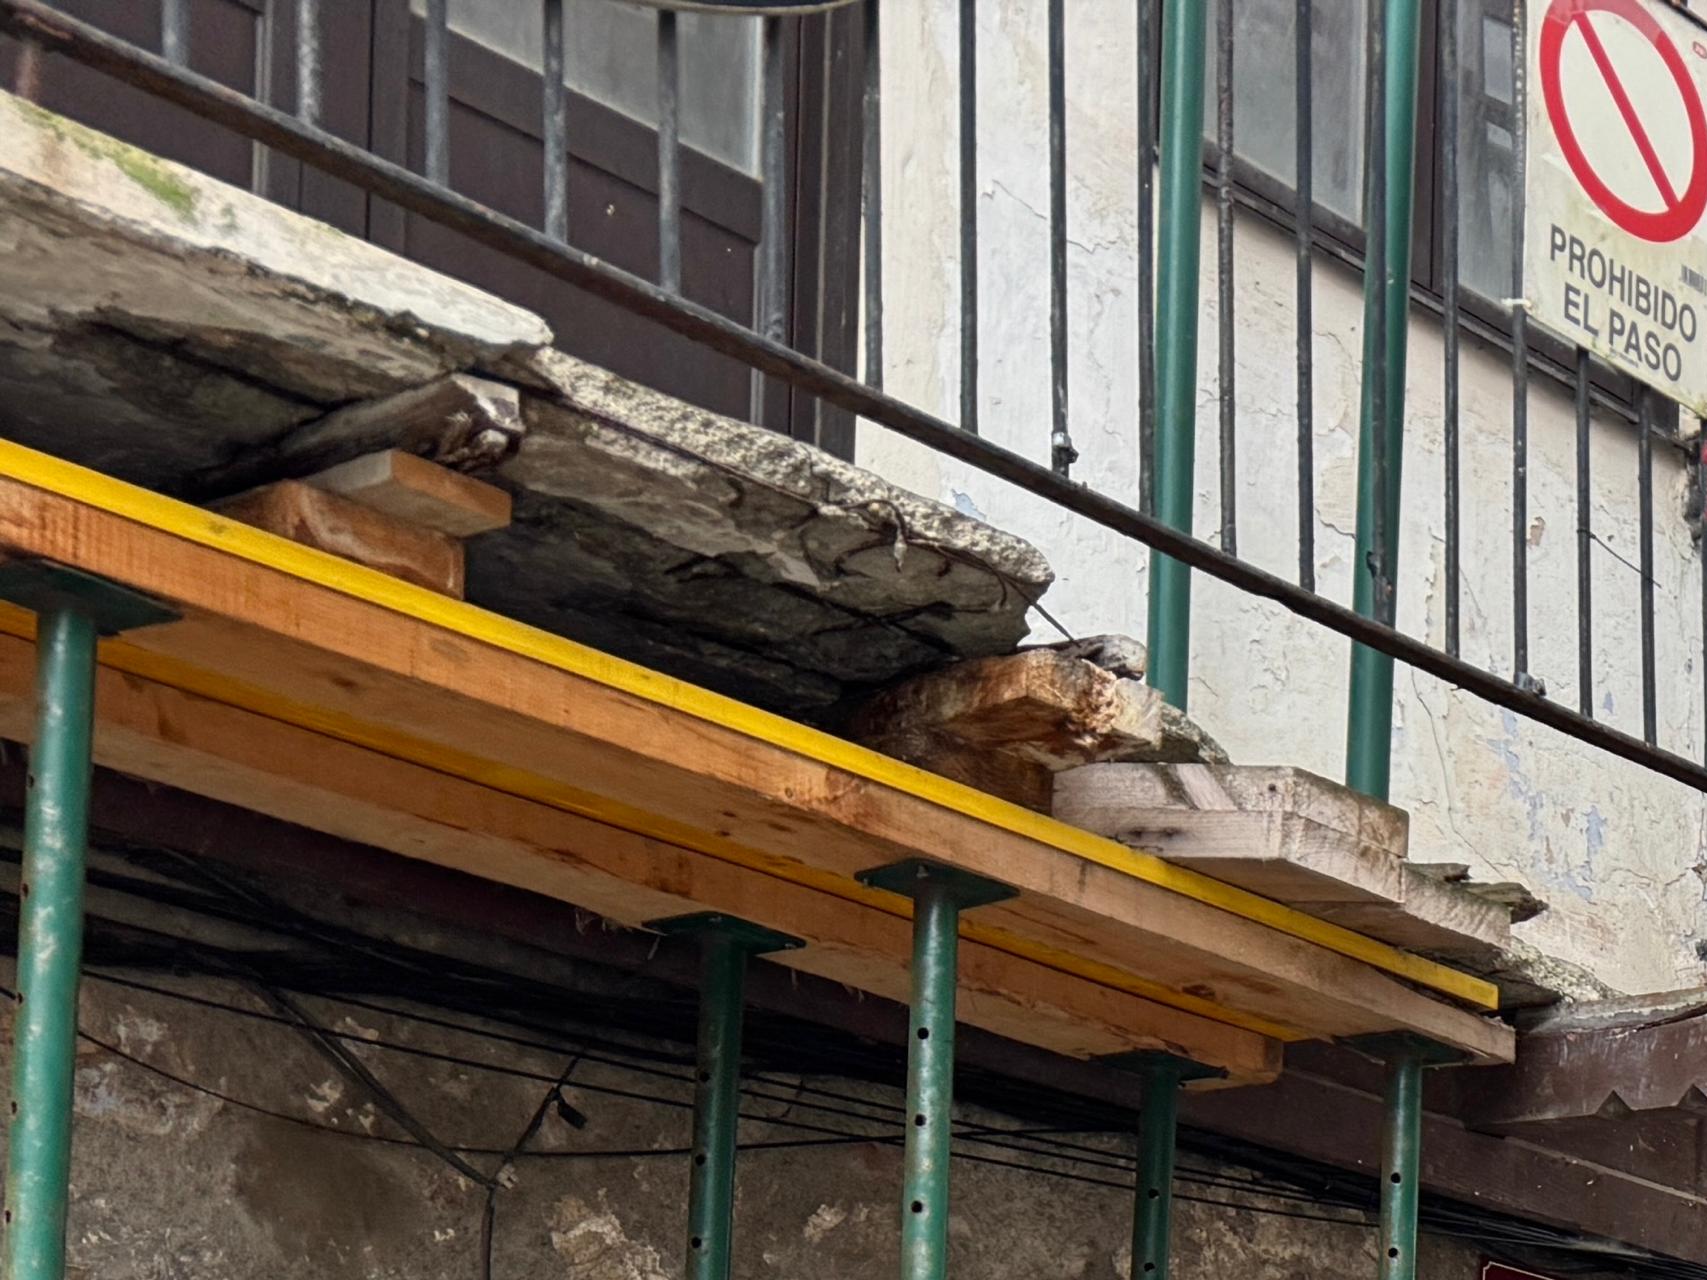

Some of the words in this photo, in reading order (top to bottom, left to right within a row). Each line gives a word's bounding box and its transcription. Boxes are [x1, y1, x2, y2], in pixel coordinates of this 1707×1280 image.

[1550, 223, 1697, 342] PROHIBIDO
[1564, 281, 1599, 337] EL
[1608, 308, 1682, 382] PASO
